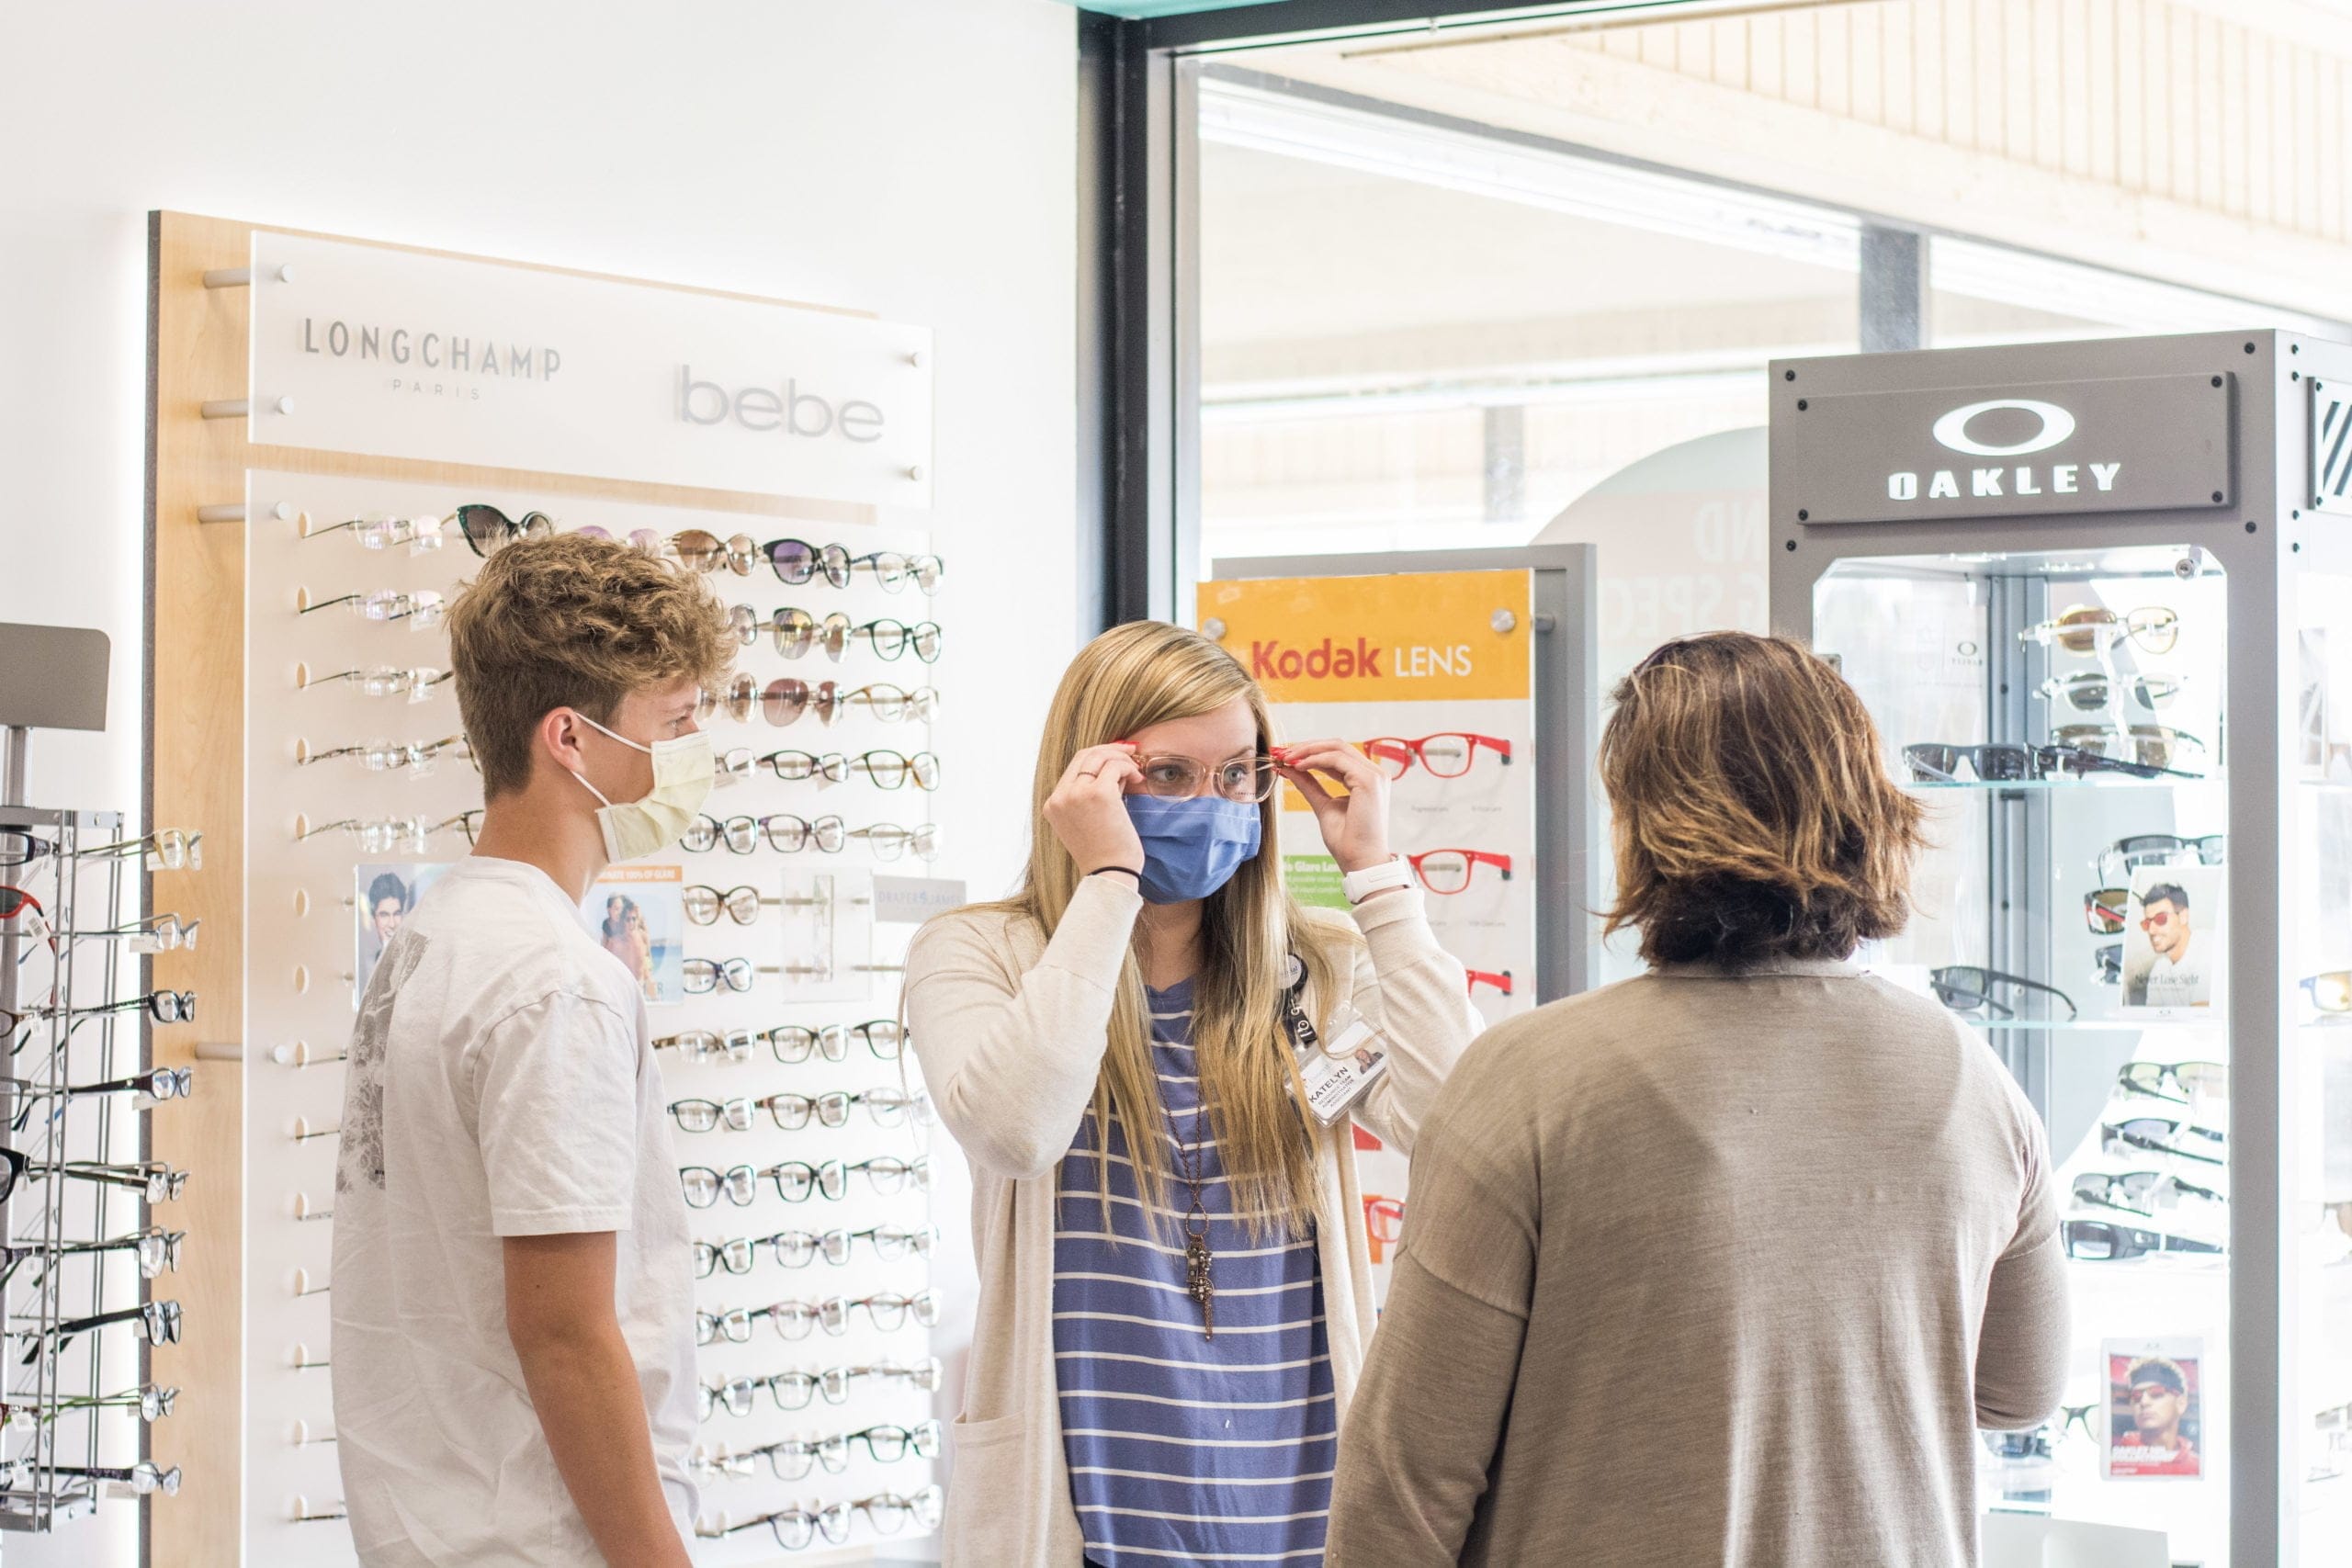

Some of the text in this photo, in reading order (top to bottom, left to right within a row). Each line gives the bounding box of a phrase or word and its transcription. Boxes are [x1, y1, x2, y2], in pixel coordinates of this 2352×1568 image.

[304, 318, 562, 382] LONGCHAMP
[392, 378, 482, 401] PARIS
[679, 364, 886, 445] bebe
[1887, 462, 2122, 502] OAKLEY
[1251, 637, 1473, 680] Kodak LENS
[2134, 973, 2158, 985] Never
[2160, 974, 2178, 985] Lose
[1308, 1066, 1349, 1103] KATELYN
